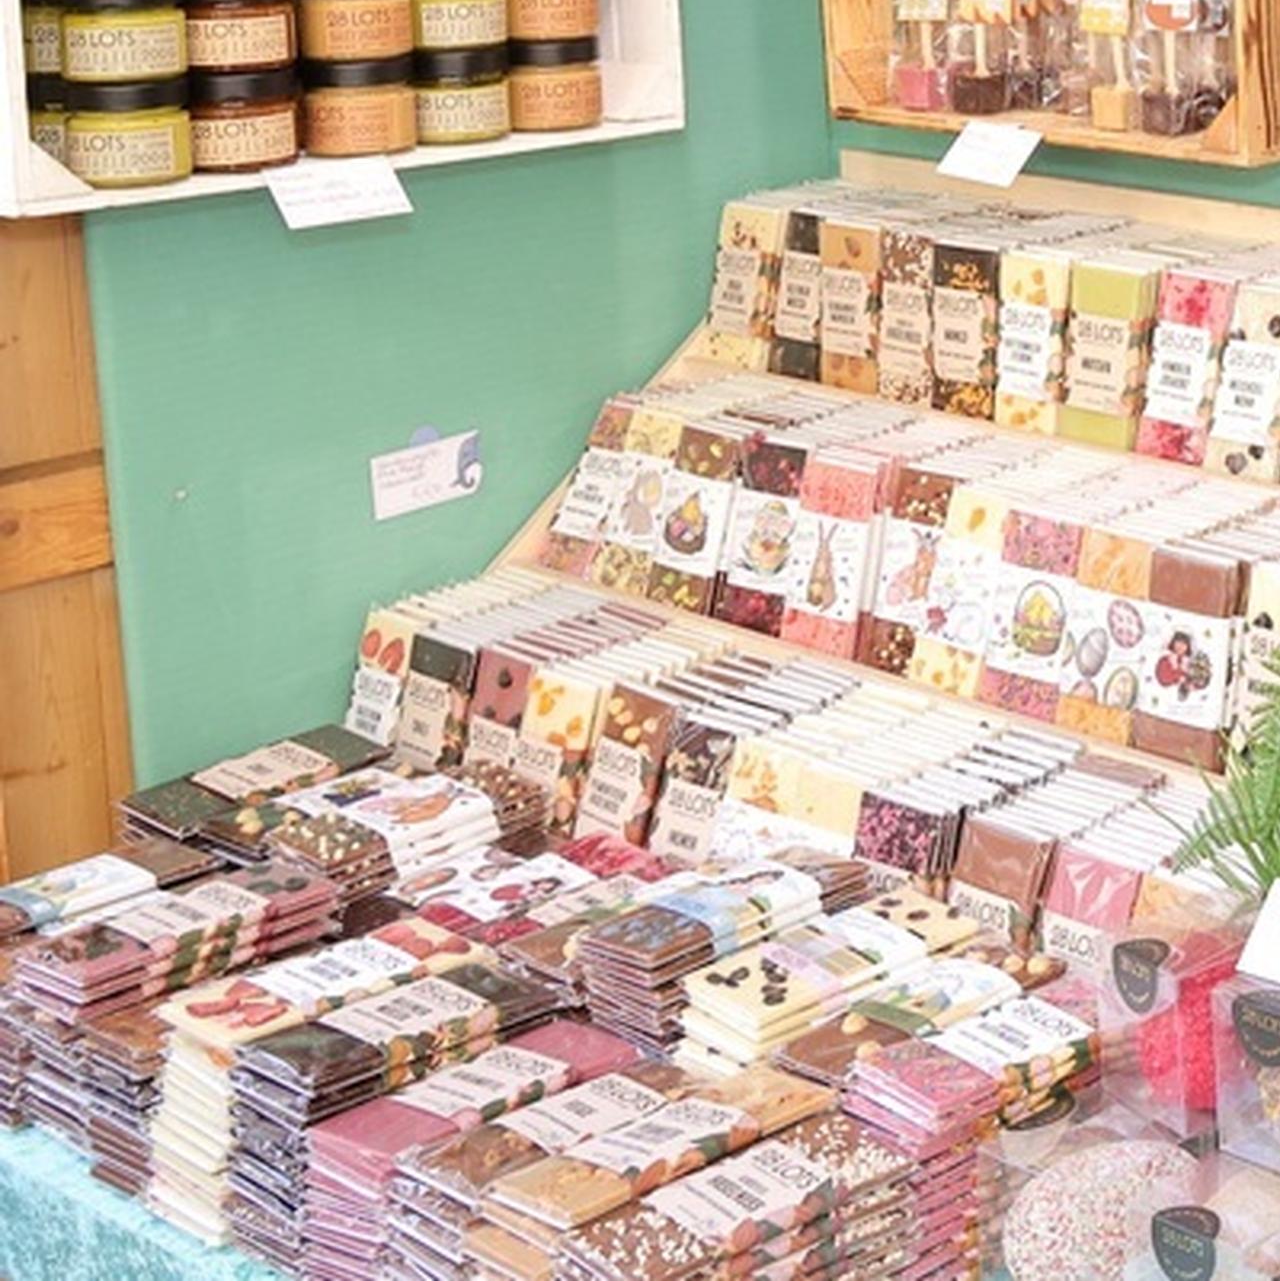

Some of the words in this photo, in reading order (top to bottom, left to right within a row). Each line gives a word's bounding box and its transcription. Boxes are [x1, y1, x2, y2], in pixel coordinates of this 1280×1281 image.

[89, 30, 136, 49] LOTS
[204, 22, 248, 40] LOTS
[435, 94, 474, 110] LOTS
[215, 120, 259, 139] LOTS
[82, 135, 125, 153] LOTS
